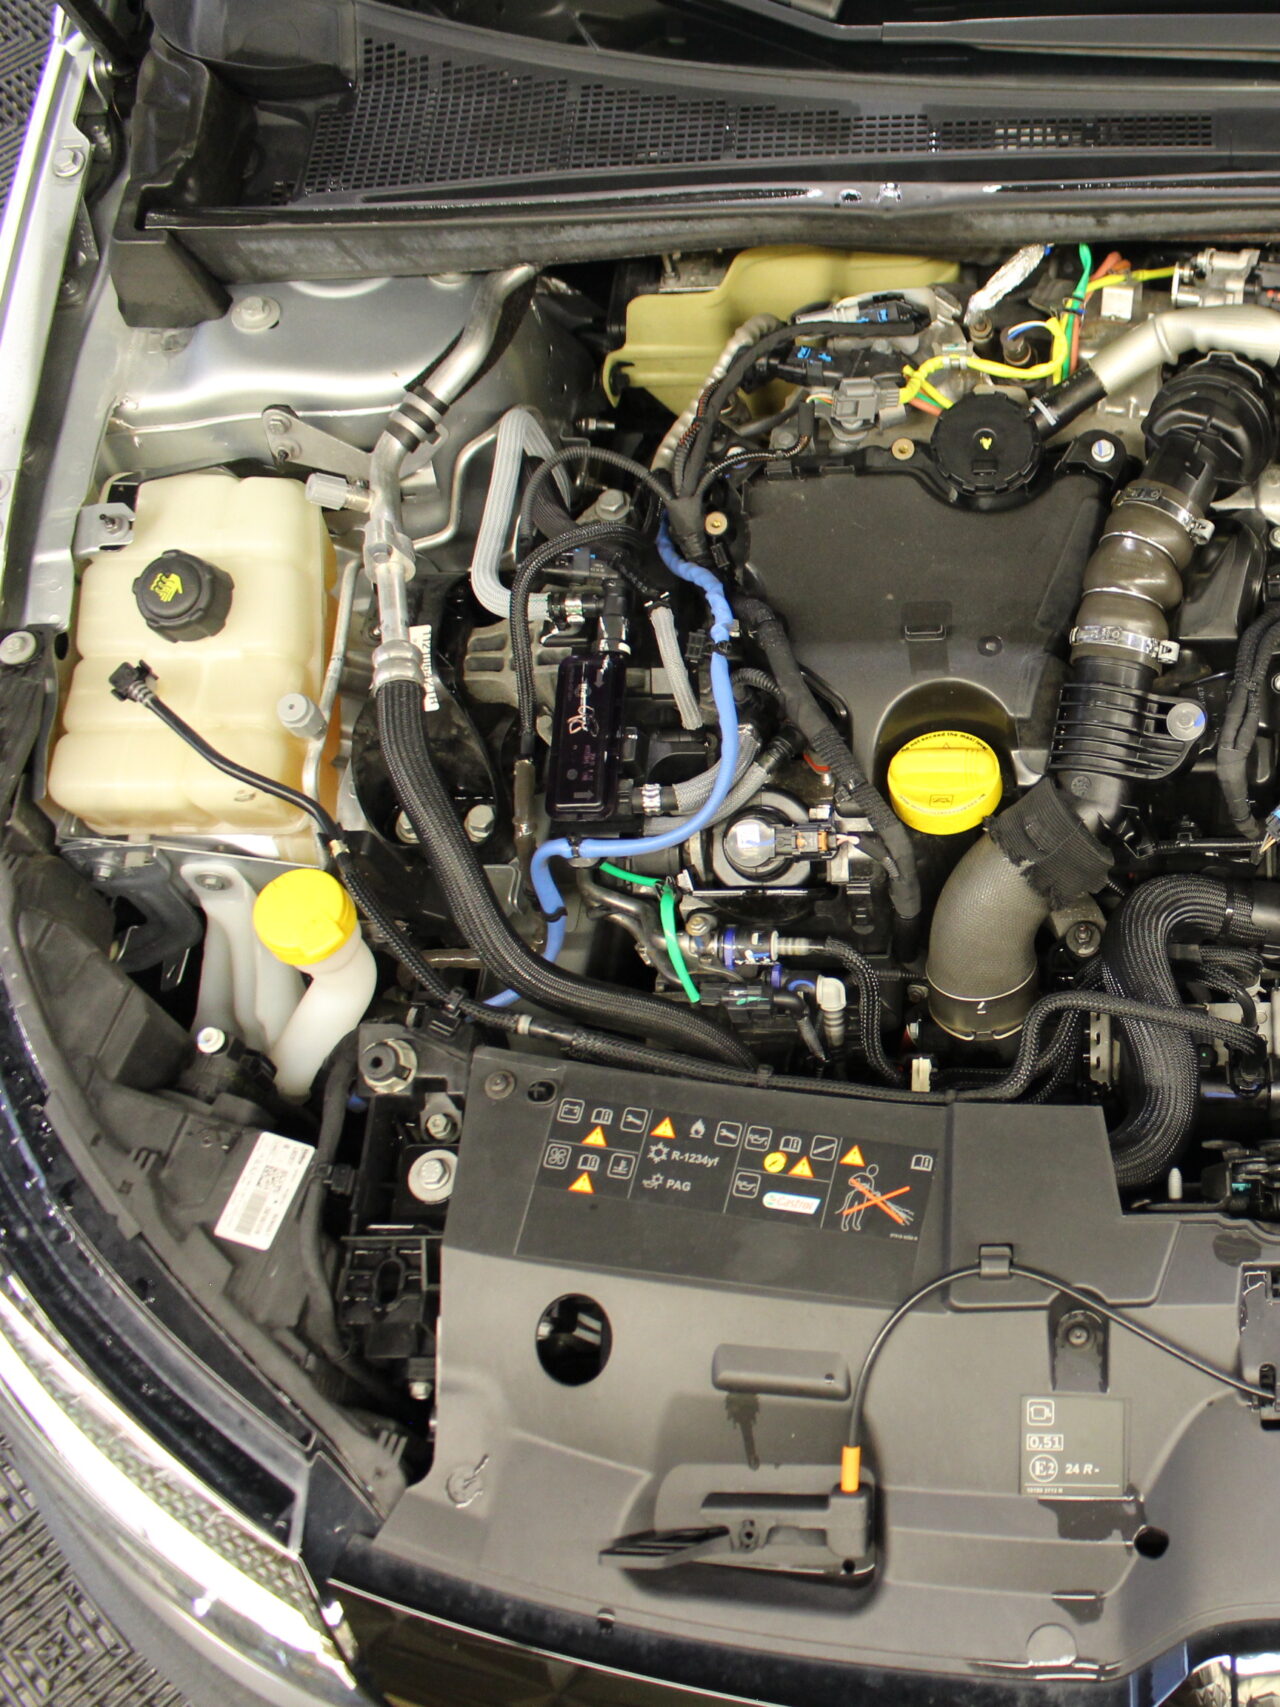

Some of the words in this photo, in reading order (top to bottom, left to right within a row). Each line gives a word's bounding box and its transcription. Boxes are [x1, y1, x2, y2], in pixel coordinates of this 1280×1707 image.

[921, 732, 945, 741] exceed
[671, 1150, 720, 1168] R-1234yf
[666, 1179, 692, 1192] PAG
[1029, 1436, 1060, 1449] 0,51
[1034, 1460, 1056, 1476] E2
[1065, 1463, 1080, 1475] 24
